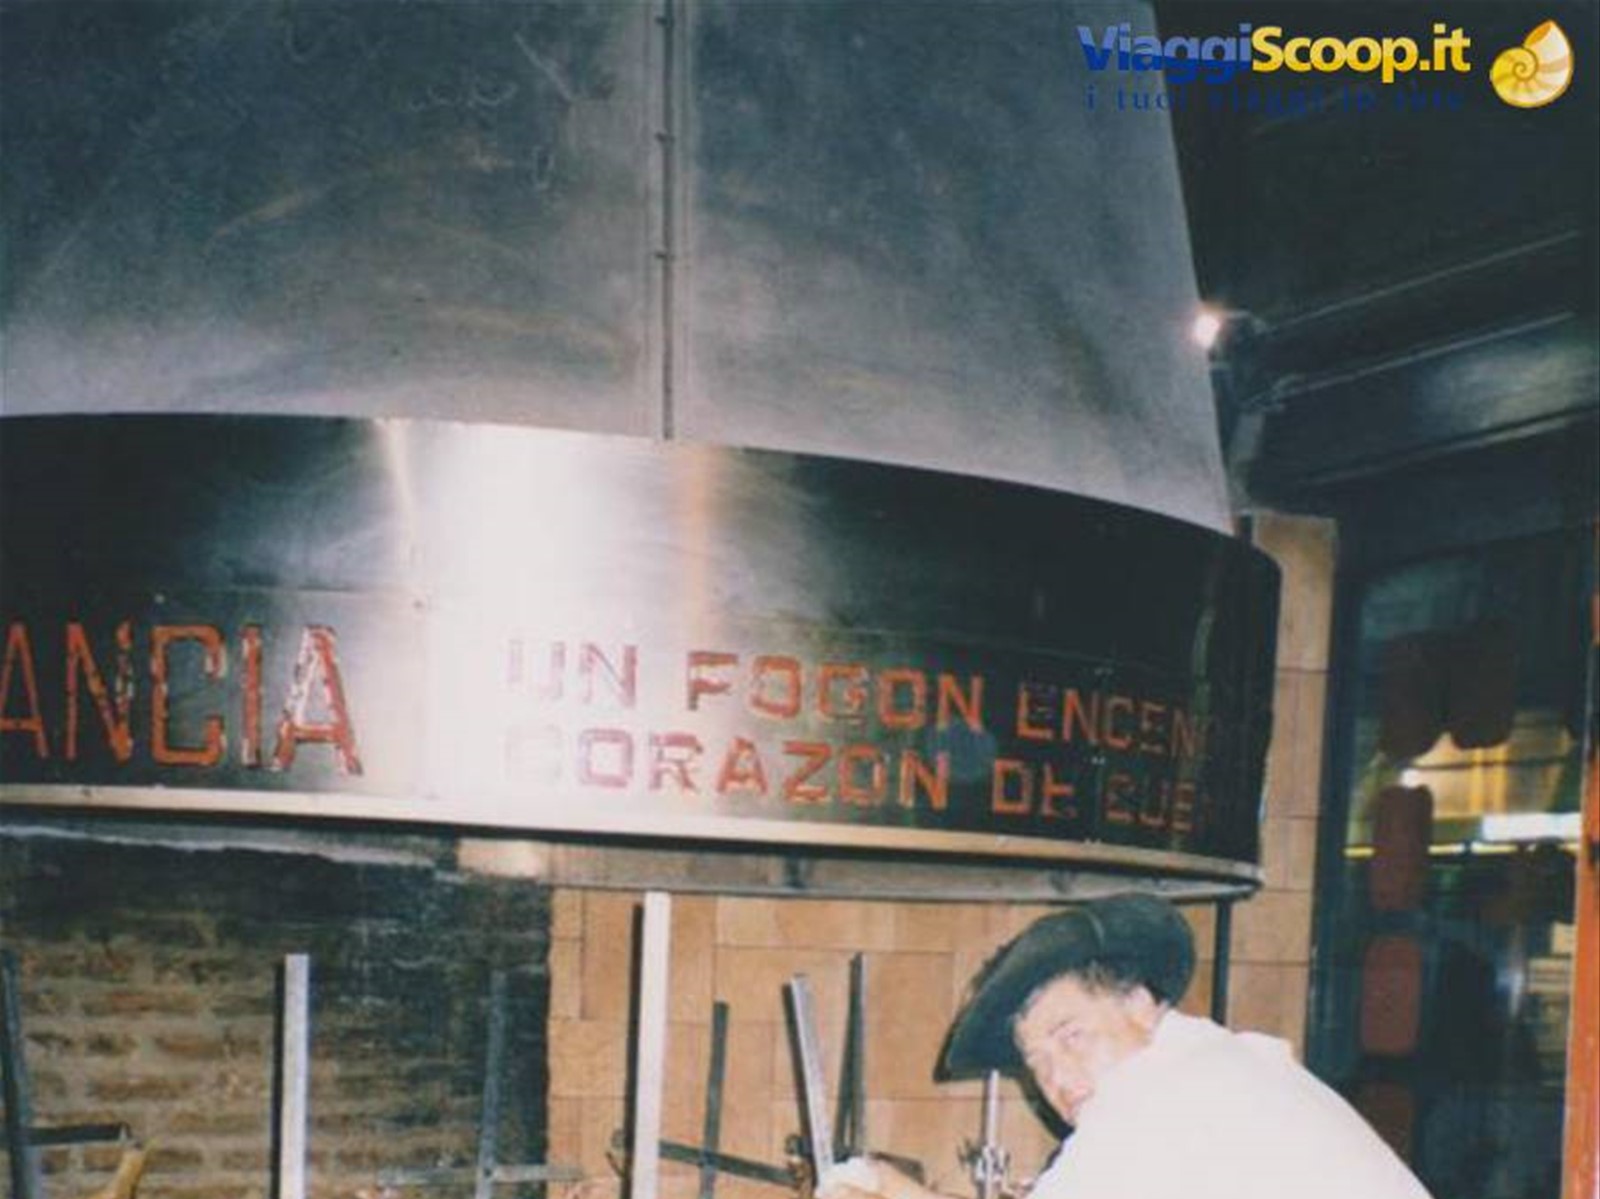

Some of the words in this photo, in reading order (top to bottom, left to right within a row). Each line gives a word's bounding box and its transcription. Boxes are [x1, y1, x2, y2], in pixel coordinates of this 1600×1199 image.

[0, 620, 363, 776] ANCIA
[507, 639, 638, 708] UN
[687, 650, 984, 732] FOGON
[992, 757, 1077, 820] DE
